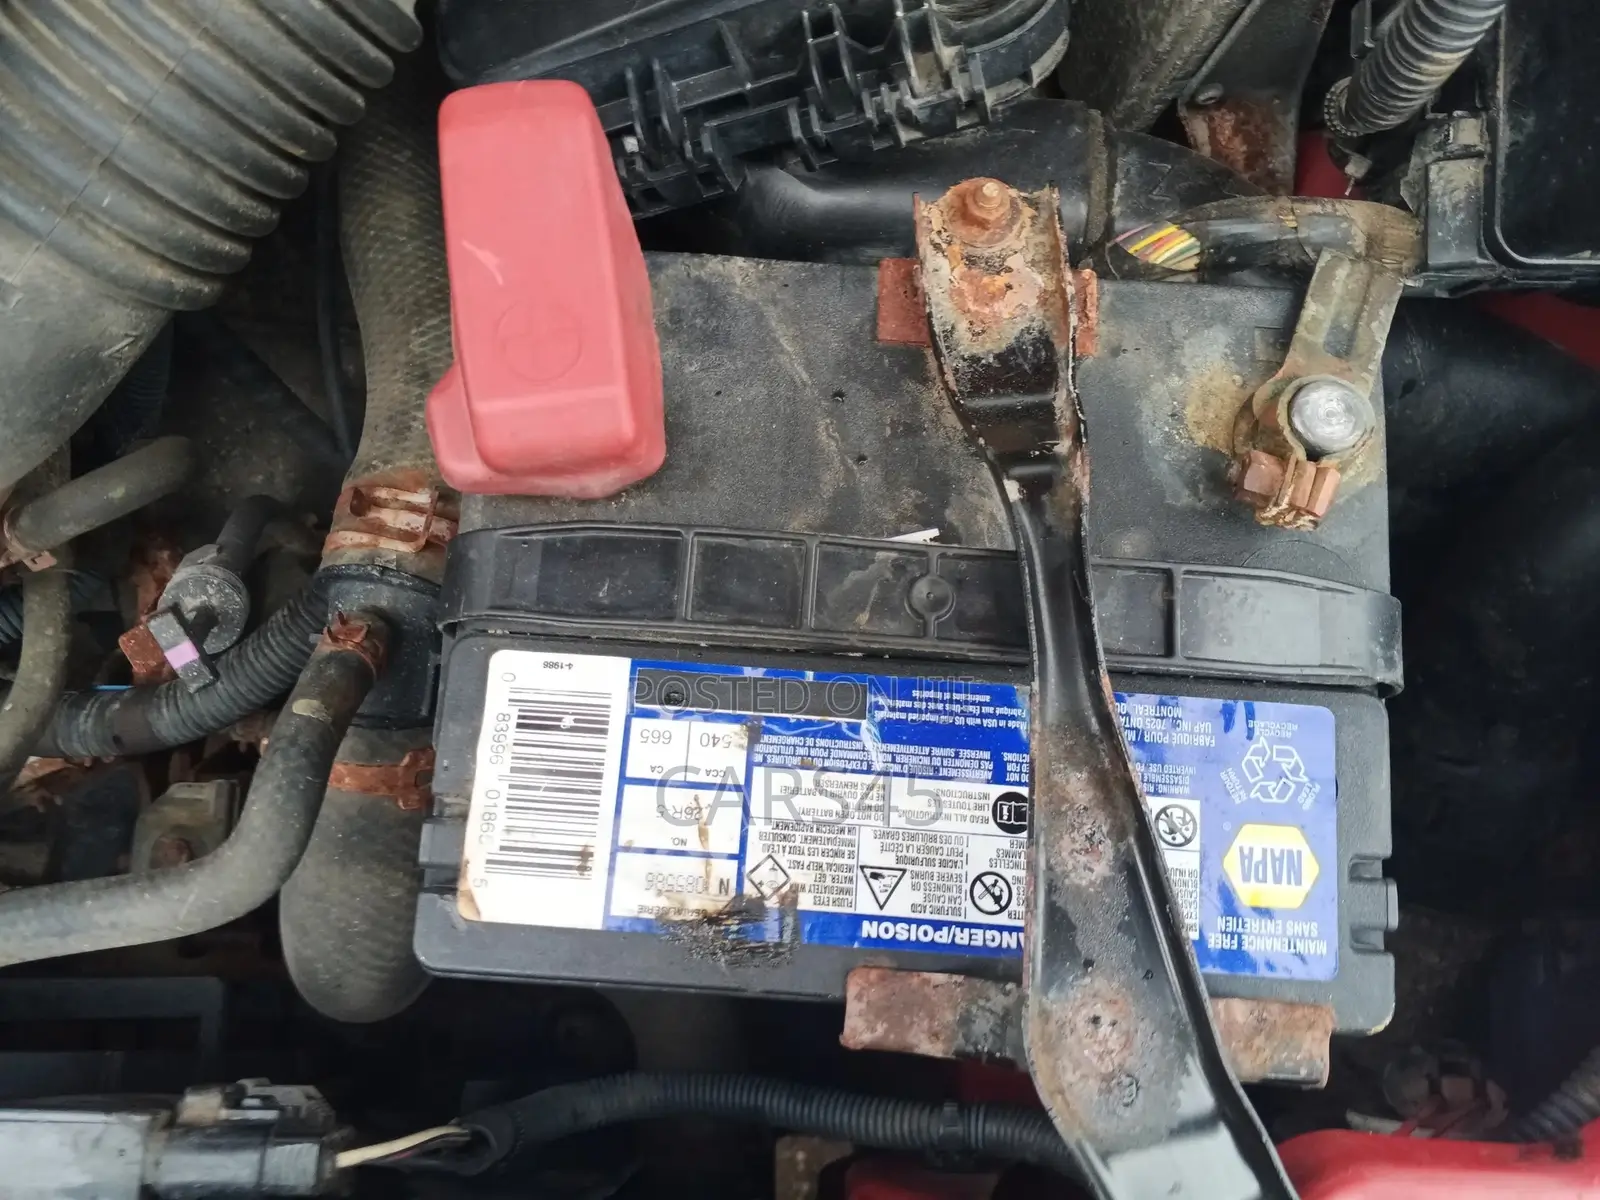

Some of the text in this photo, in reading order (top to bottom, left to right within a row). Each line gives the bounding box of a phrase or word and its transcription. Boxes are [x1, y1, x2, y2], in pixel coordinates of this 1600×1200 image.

[501, 673, 516, 683] 0
[874, 711, 907, 721] materials
[995, 706, 1026, 718] Fabriqué
[908, 712, 939, 724] imported
[955, 716, 965, 726] US
[967, 717, 981, 726] with
[983, 718, 998, 727] USA
[1119, 716, 1143, 728] ONTA
[999, 719, 1007, 729] in
[1008, 720, 1027, 730] Made
[1145, 718, 1166, 730] 7025
[1194, 721, 1212, 733] UAP
[489, 712, 510, 765] 83996
[640, 728, 672, 746] 665
[699, 732, 732, 749] 540
[805, 737, 814, 746] DE
[1144, 730, 1169, 744] POUR
[1172, 732, 1215, 748] FABRIQUÉ
[816, 738, 862, 749] INSTRUCTIONS
[795, 747, 808, 756] UNE
[810, 748, 828, 757] POUR
[830, 749, 876, 761] ECOMMANDÉ
[931, 747, 955, 757] SUIVRE
[1001, 752, 1029, 762] CTIONS.
[650, 765, 663, 775] CA
[980, 760, 993, 770] PAS
[1007, 763, 1020, 772] FOR
[705, 768, 727, 779] CCA
[939, 767, 993, 779] AVERTISSEMENT
[1006, 773, 1019, 782] NOT
[943, 800, 971, 811] TOUTES
[973, 802, 989, 811] LIRE
[954, 813, 968, 823] ALL
[970, 814, 989, 824] READ
[670, 837, 688, 847] NO.
[788, 845, 805, 856] YEUX
[807, 846, 819, 856] LES
[847, 849, 855, 859] SE
[905, 844, 914, 853] LA
[916, 845, 944, 856] CAUSER
[946, 847, 964, 857] PEUT
[996, 848, 1026, 860] LAMMES
[895, 854, 963, 869] L'ACIDE SULFURIQUE
[989, 857, 1027, 870] TINCELLES
[1239, 845, 1302, 886] NAPA
[813, 873, 827, 883] GET
[936, 872, 963, 883] SEVERE
[719, 879, 729, 896] N
[911, 881, 963, 894] BLINDNESS OR
[813, 895, 830, 907] EYES
[923, 893, 962, 906] CAN CAUSE
[911, 903, 962, 917] SULFURIC ACID
[1217, 915, 1282, 934] ENTRETIEN
[1284, 920, 1318, 937] SANS
[862, 920, 1025, 950] ANGER/POISON
[1208, 932, 1326, 954] MAINTENANCE FREE
